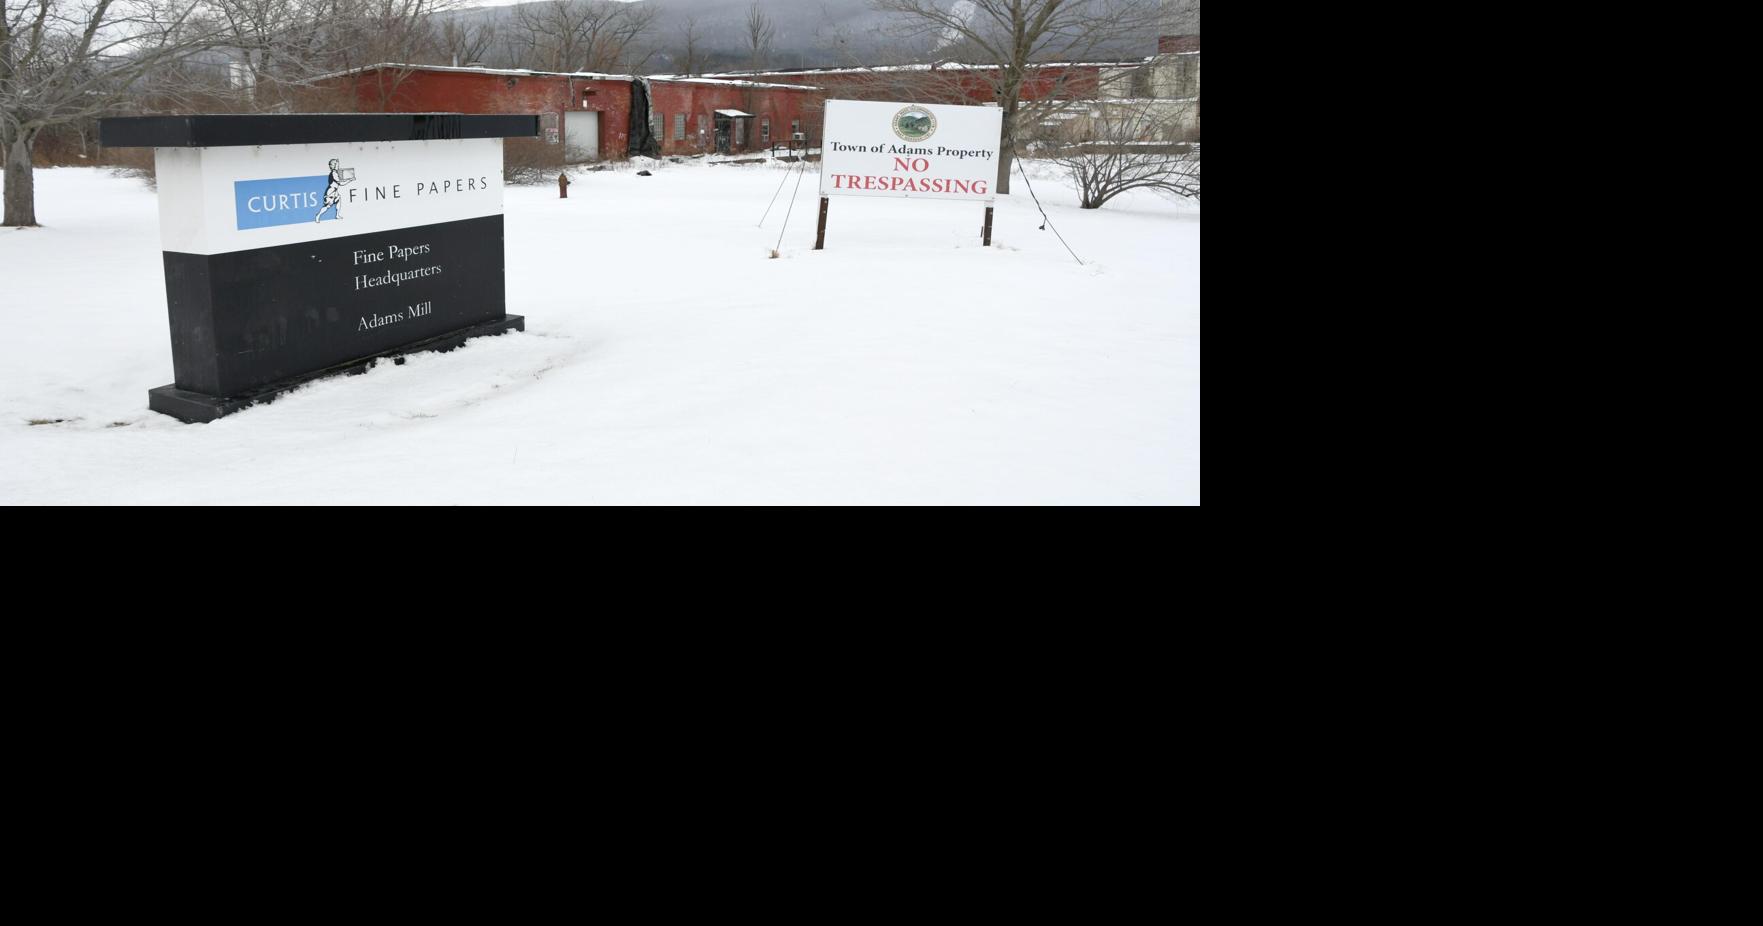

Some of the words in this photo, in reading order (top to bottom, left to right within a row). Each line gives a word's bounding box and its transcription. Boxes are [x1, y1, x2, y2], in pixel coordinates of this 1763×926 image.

[830, 141, 867, 153] Town
[870, 143, 886, 153] of
[887, 144, 933, 156] Adams
[937, 146, 994, 160] Property
[893, 156, 930, 173] NO
[350, 184, 401, 203] FINE
[417, 176, 488, 196] PAPERS
[831, 174, 988, 195] TRESPASSING
[247, 191, 318, 213] CURTIS
[353, 249, 384, 265] Fine
[389, 243, 430, 261] Papers
[354, 263, 442, 290] Headquarters
[357, 312, 403, 331] Adams
[408, 301, 432, 319] Mill
